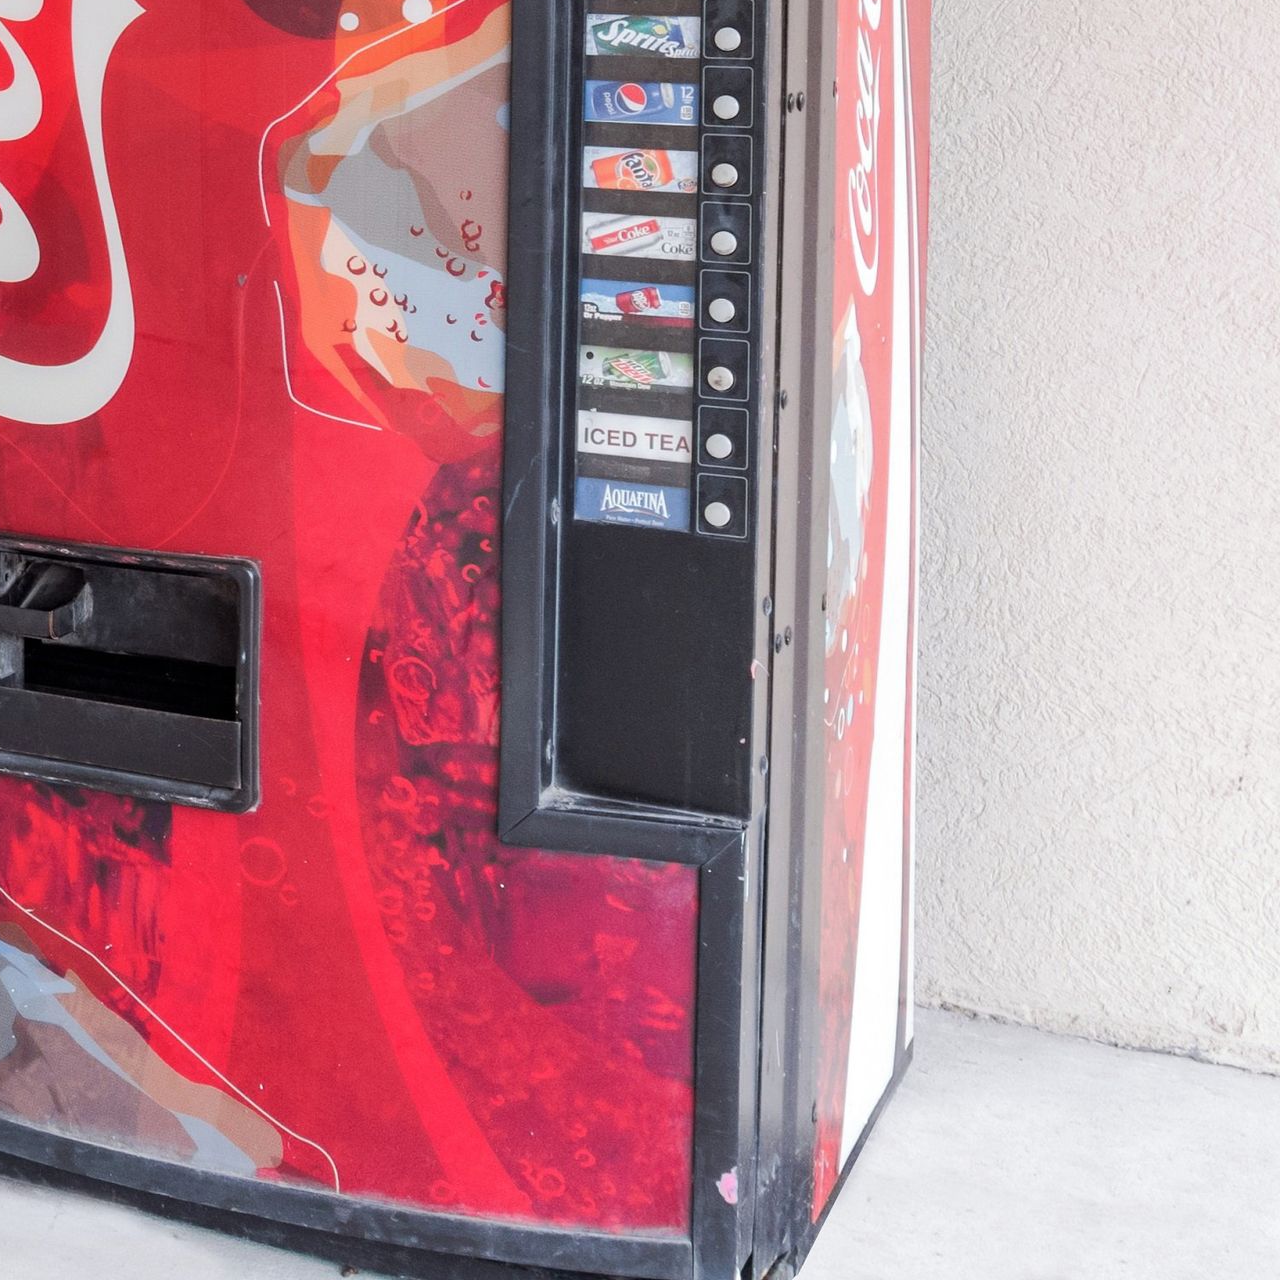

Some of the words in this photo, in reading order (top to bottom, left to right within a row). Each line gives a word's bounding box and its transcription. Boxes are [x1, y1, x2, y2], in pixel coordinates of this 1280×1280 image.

[597, 20, 680, 53] Sprite
[681, 86, 695, 99] 12
[617, 225, 651, 242] Coke
[661, 242, 693, 255] Coke
[582, 375, 592, 384] 12
[584, 428, 638, 448] ICED
[644, 433, 690, 453] TEA
[600, 484, 670, 519] AQUAFINA
